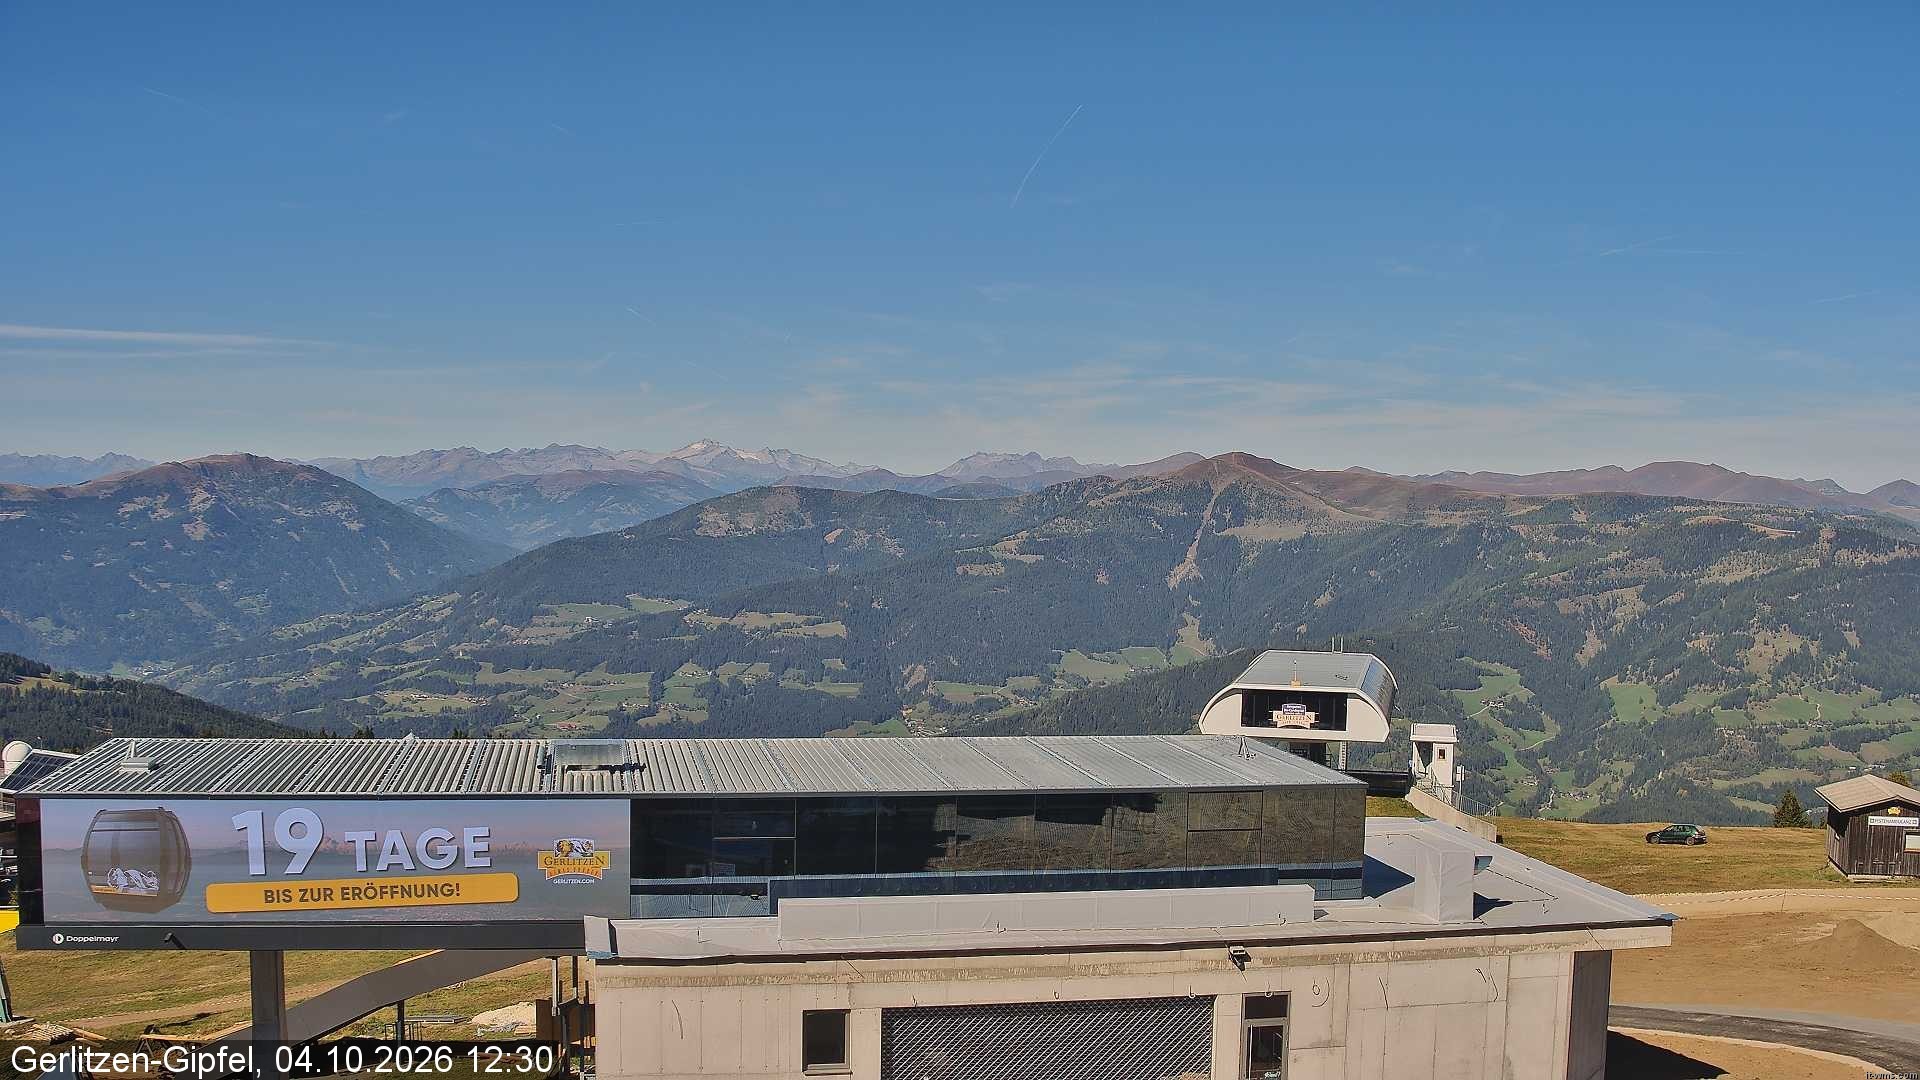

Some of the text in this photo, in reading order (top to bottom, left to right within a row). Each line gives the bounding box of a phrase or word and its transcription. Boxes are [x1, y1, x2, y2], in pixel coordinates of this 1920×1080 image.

[231, 807, 492, 876] 19 TAGE
[544, 855, 605, 866] GERLITZEN
[263, 882, 461, 904] BIS ZUR ERÖFFNUNG!
